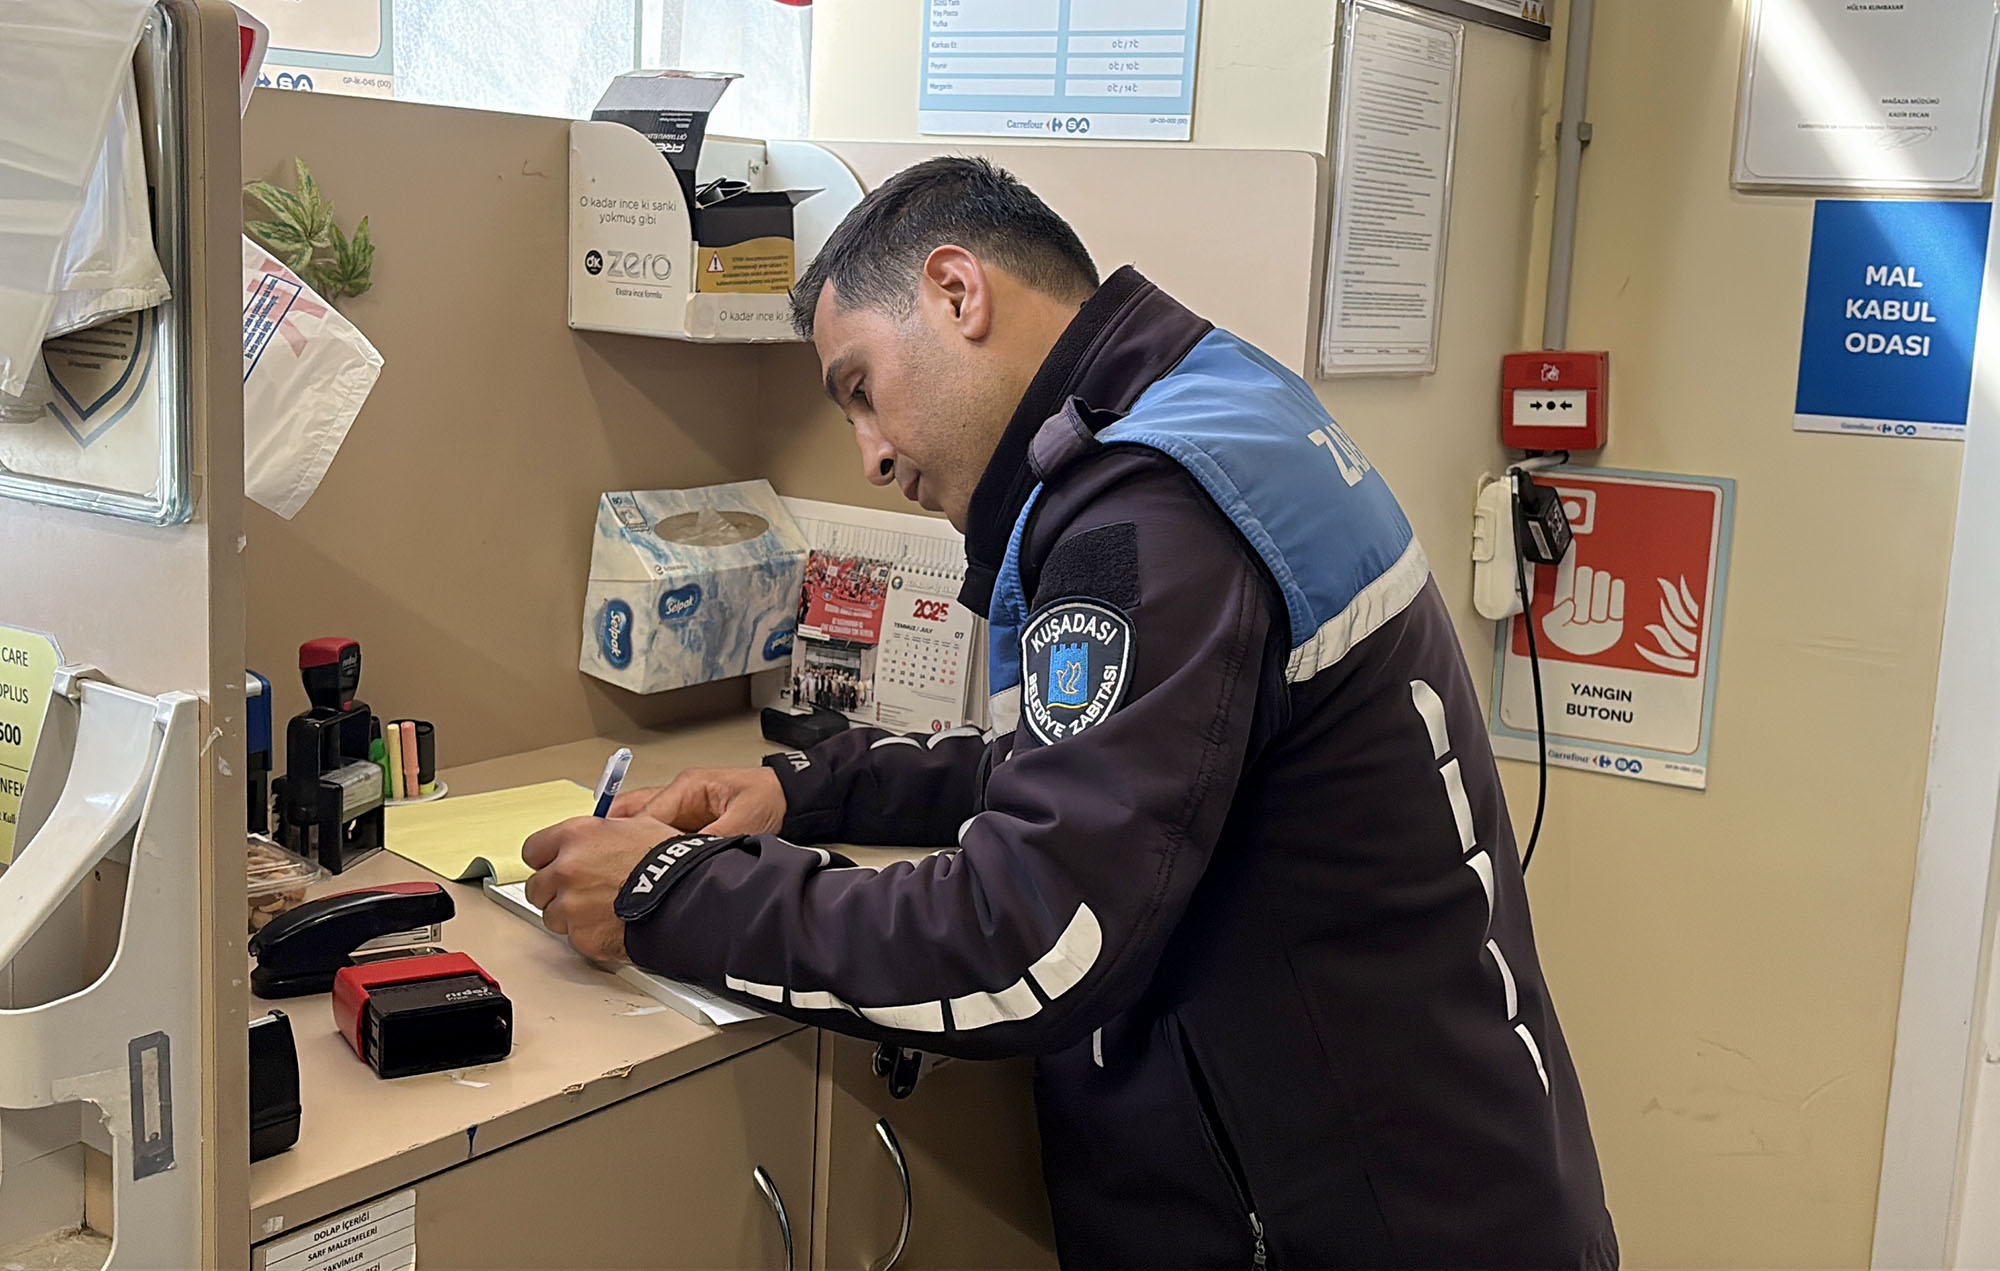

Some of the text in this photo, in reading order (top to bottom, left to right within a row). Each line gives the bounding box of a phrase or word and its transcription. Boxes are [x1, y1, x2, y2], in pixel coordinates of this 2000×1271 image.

[1006, 119, 1044, 130] Carrefour
[580, 196, 677, 211] O kadar ince ki sanki
[600, 212, 657, 226] yokmuş gibi
[1865, 265, 1923, 288] MAL
[730, 312, 754, 321] kadar
[756, 312, 774, 321] ince
[1845, 298, 1936, 322] KABUL
[1845, 332, 1931, 357] ODASI
[665, 594, 695, 615] Selpak
[913, 599, 949, 622] 2025
[610, 610, 622, 658] Selpak
[954, 632, 964, 640] 07
[1030, 613, 1118, 654] KUŞADASI
[1, 647, 29, 667] CARE
[1068, 665, 1119, 736] ZABITASI
[1571, 683, 1632, 702] YANGIN
[1028, 672, 1067, 739] BELEDİYE
[1566, 703, 1634, 723] BUTONU
[632, 836, 724, 894] ABITA
[313, 1211, 370, 1242] DOLAP İÇERİĞİ
[307, 1226, 378, 1262] SARF MALZEMELERİ
